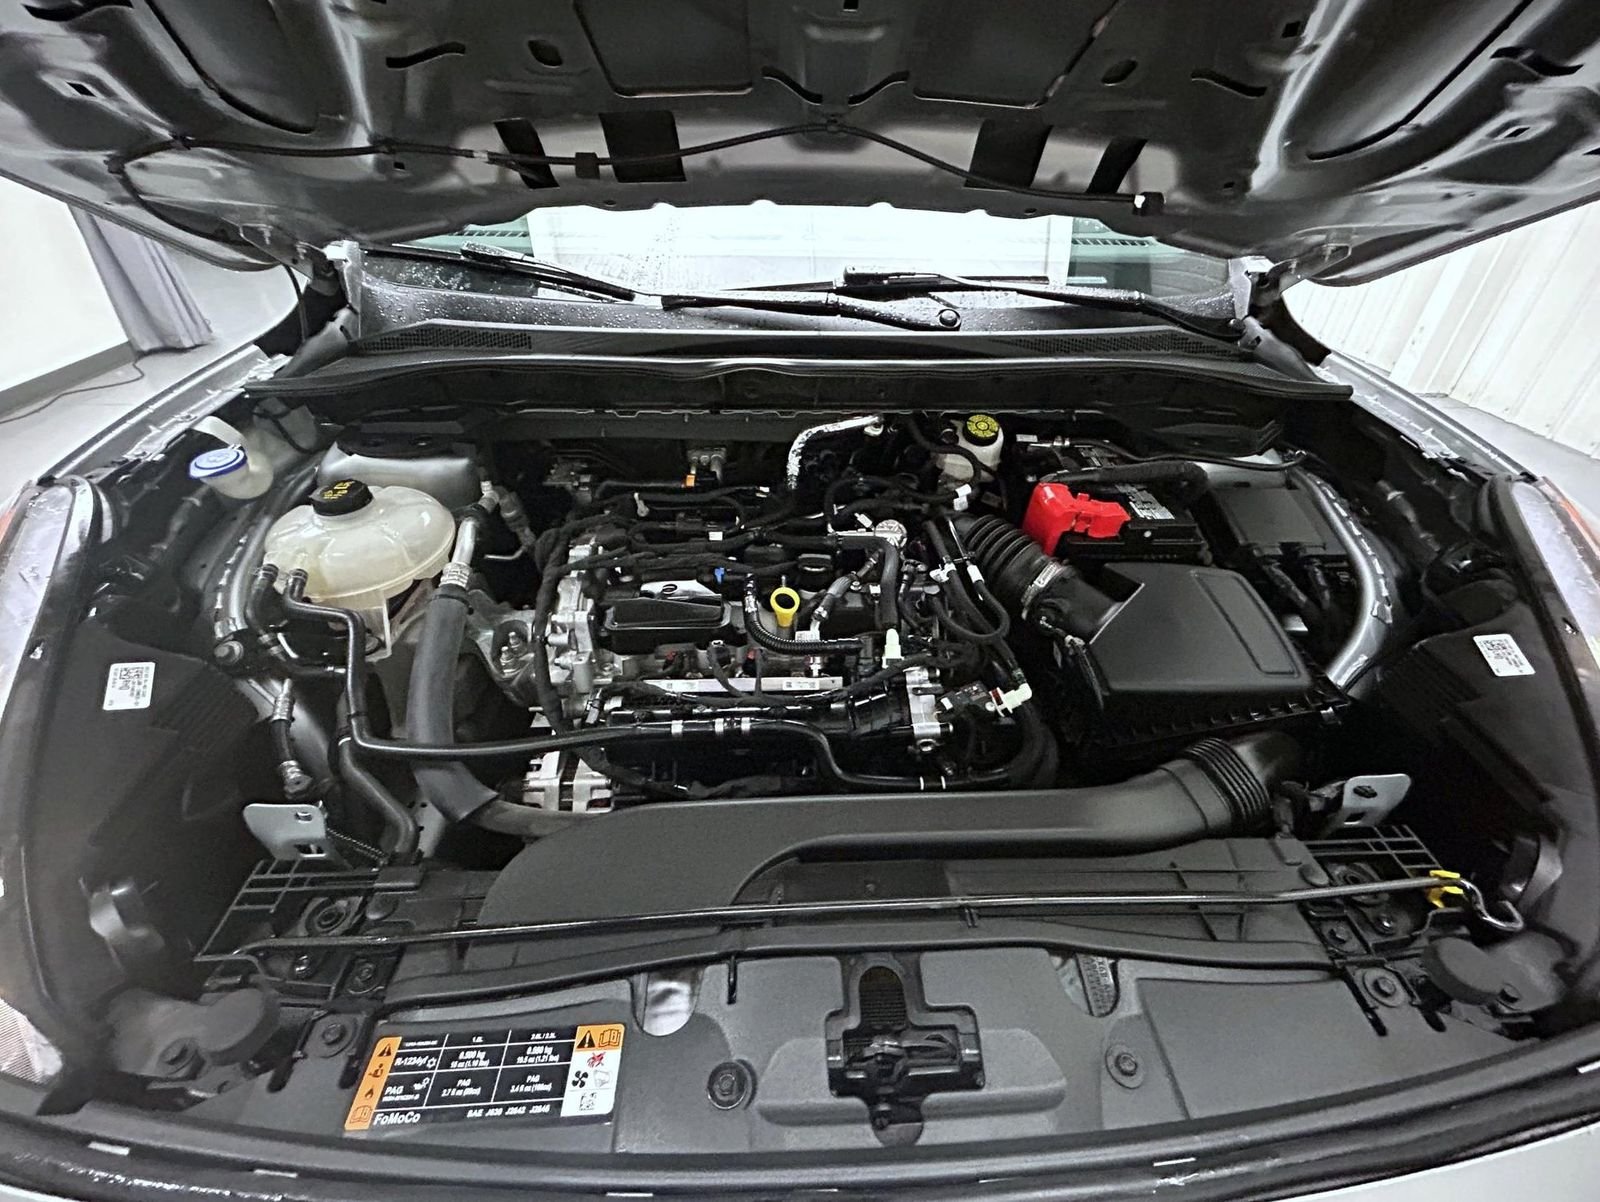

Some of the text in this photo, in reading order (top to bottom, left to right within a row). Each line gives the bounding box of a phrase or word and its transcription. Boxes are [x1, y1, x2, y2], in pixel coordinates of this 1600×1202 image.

[544, 1045, 554, 1055] kg
[476, 1050, 487, 1061] kg
[456, 1078, 472, 1087] PAG
[526, 1074, 541, 1083] PAG
[384, 1085, 404, 1095] PAG
[372, 1110, 421, 1125] FoMoCo
[466, 1108, 484, 1118] SAE
